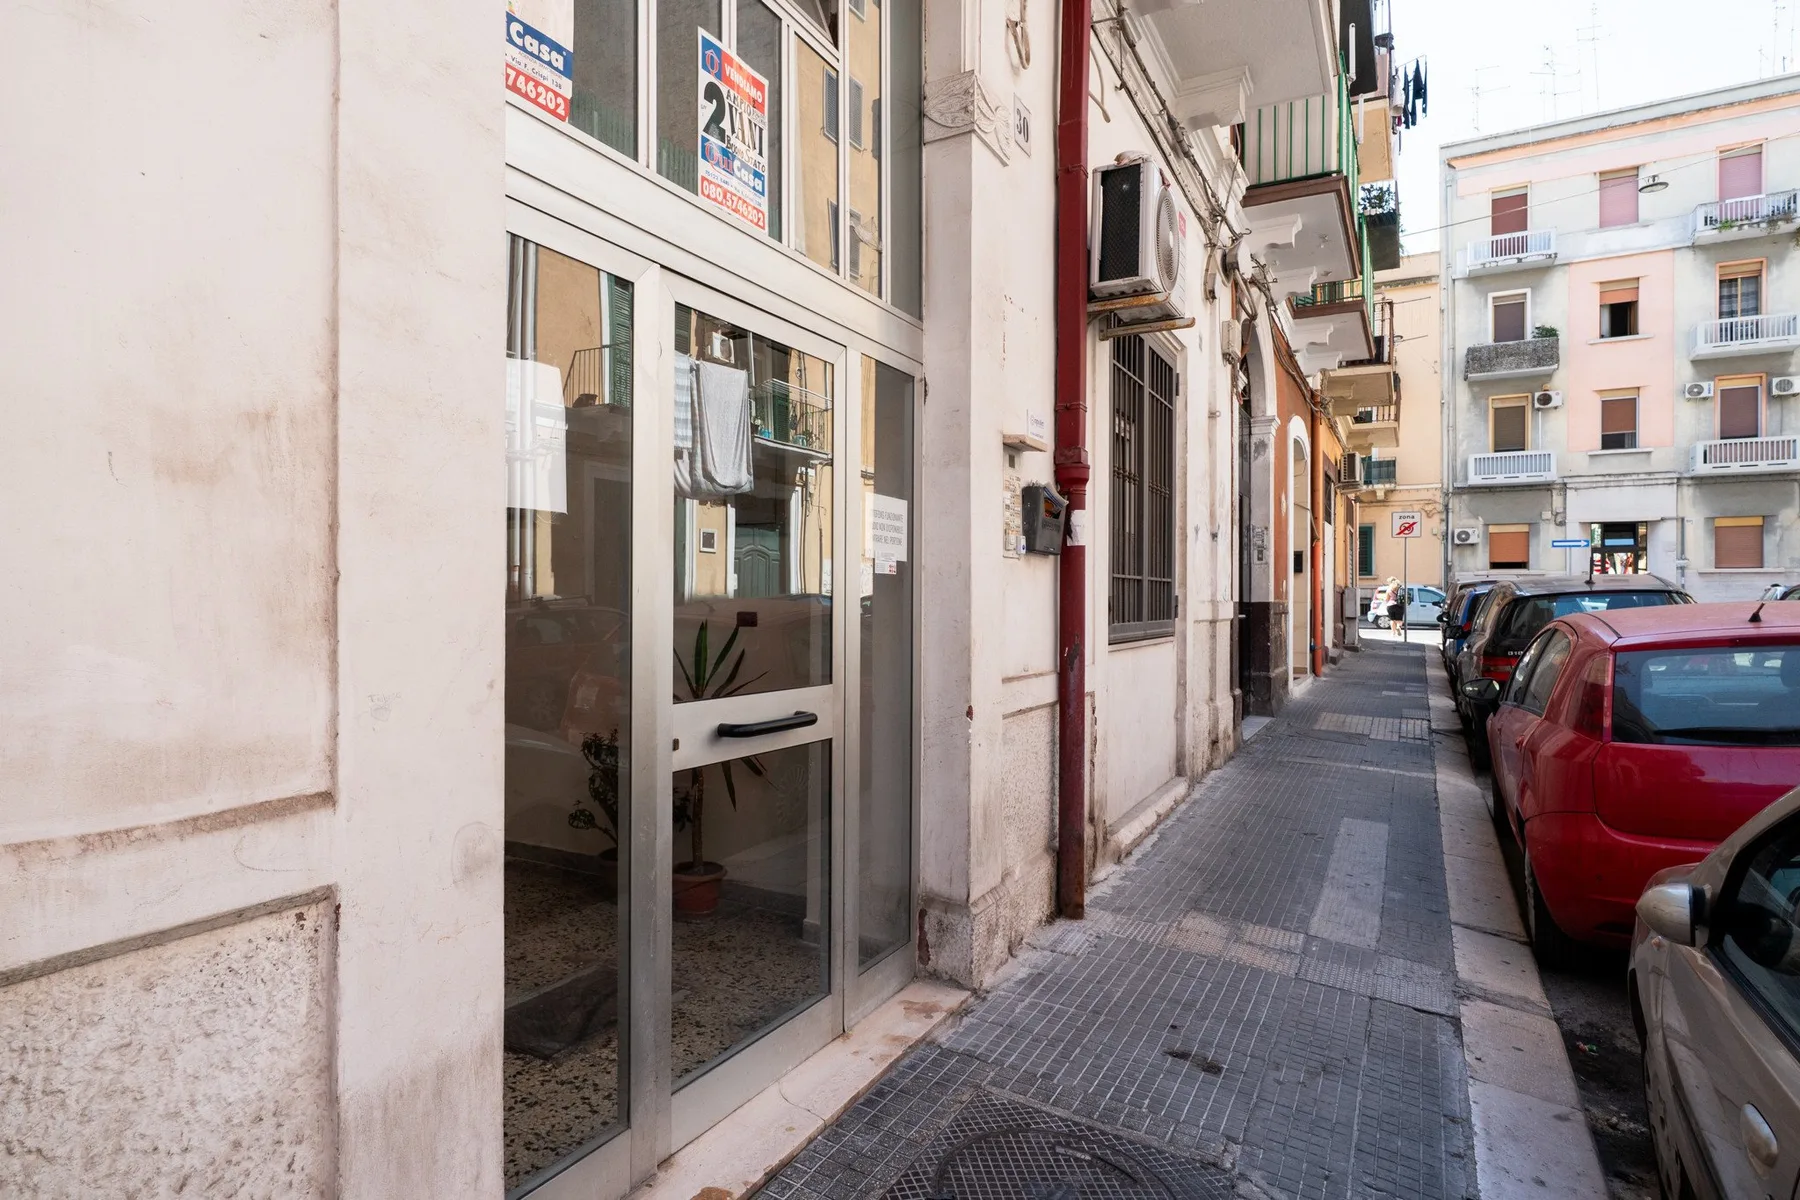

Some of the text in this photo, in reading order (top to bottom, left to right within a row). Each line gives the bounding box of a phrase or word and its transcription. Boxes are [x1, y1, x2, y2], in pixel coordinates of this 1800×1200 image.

[511, 55, 521, 66] Via
[532, 67, 548, 81] Crispi
[724, 63, 763, 104] VENDIAMO
[702, 81, 764, 158] 2 VANI
[1016, 108, 1029, 143] 30
[702, 181, 764, 227] 080.5746202
